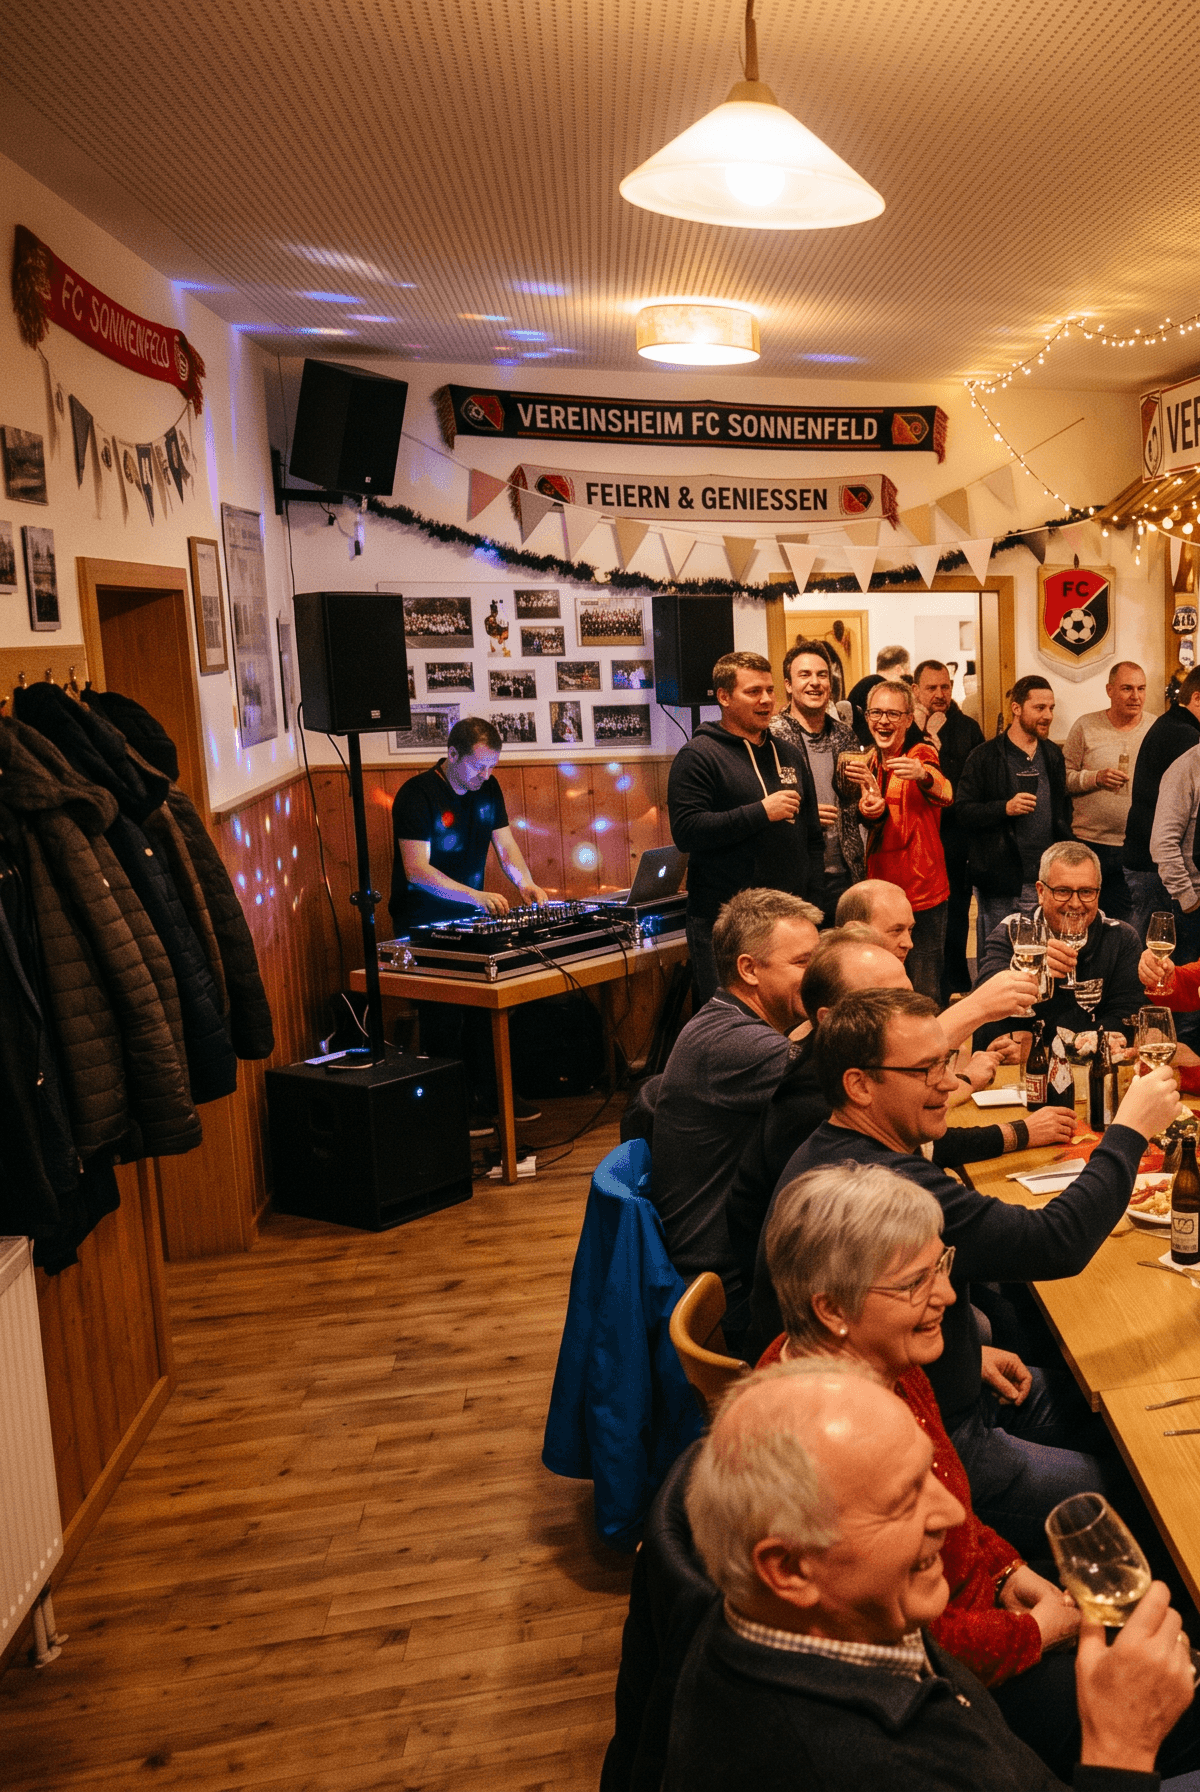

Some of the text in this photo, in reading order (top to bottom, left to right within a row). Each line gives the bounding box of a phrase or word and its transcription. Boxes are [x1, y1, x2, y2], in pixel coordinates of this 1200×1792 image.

[62, 273, 84, 321] FC
[517, 402, 878, 441] VEREINSHEIM FC SONNENFELD
[585, 482, 828, 512] FEIERN & GENIESSEN
[1062, 581, 1089, 597] FC
